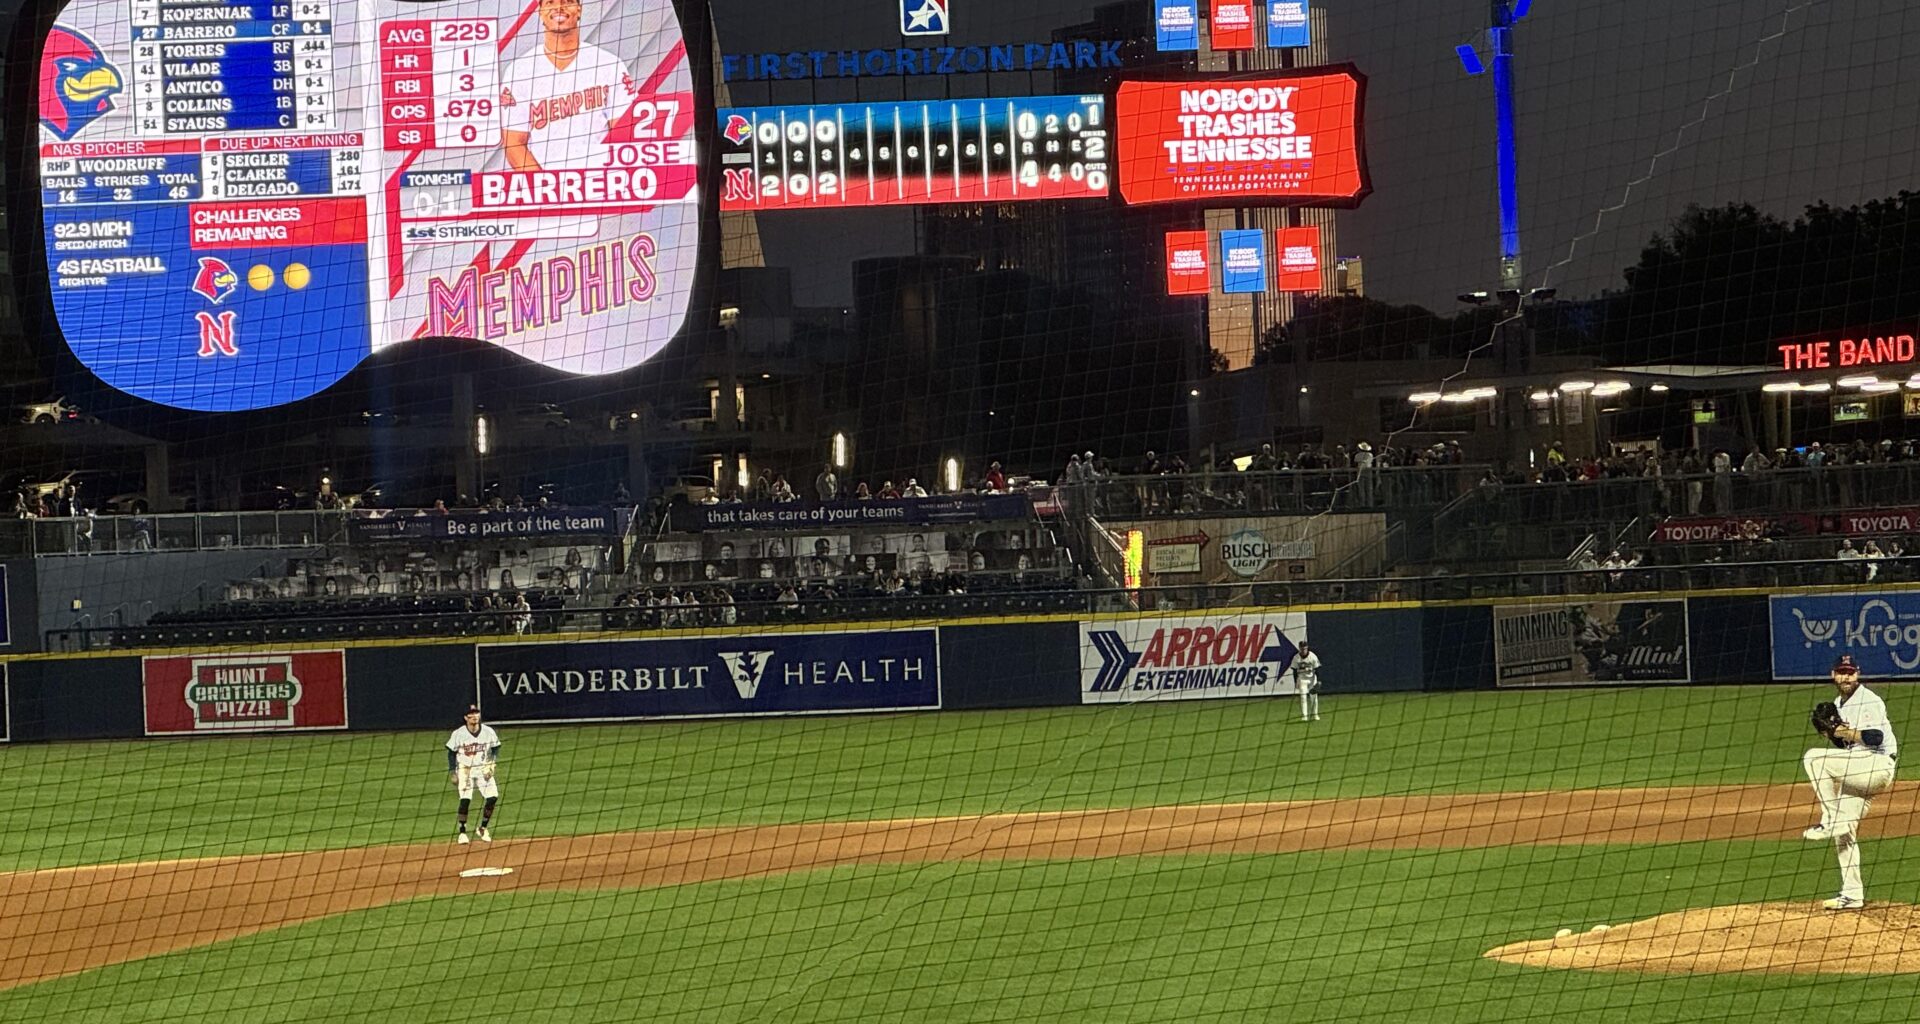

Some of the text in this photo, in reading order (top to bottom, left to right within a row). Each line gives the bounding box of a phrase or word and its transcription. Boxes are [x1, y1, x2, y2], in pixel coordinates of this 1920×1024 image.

[141, 5, 320, 21] 7 KOPERNIAK LF 0-2
[142, 23, 322, 39] 27 BARRERO CF 0-1
[387, 23, 490, 43] AVG .229
[140, 41, 325, 58] 28 TORRES RF .444
[394, 49, 469, 68] HR 1
[722, 40, 1124, 81] FIRST HORIZON PARK
[141, 60, 323, 76] 41 VILADE 3B 0-1
[145, 78, 323, 94] 3 ANTICO DH 0-1
[394, 74, 474, 94] RBI 3
[166, 96, 324, 113] COLLINS 1B 0-1
[1181, 87, 1293, 113] NOBODY
[391, 99, 492, 119] OPS .679
[1088, 104, 1099, 125] 1
[143, 114, 325, 131] 51 STAUSS C 0-1
[633, 100, 680, 140] 27
[758, 112, 1082, 144] 0 0 0 0 2 0
[1178, 112, 1296, 138] TRASHES
[220, 134, 358, 150] DUE UP NEXT INNING
[398, 125, 477, 145] SB 0
[53, 142, 145, 155] NAS PITCHER
[603, 143, 680, 167] JOSE
[765, 139, 1081, 163] 1 2 3 4 5 6 7 8 9 R H E
[1085, 137, 1105, 159] 2
[1163, 136, 1312, 163] TENNESSEE
[47, 158, 167, 173] RHP WOODRUFF
[211, 151, 360, 167] 6 SEIGLER .280
[46, 173, 198, 188] BALLS STRIKES TOTAL
[211, 171, 218, 181] 7
[225, 168, 287, 181] CLARKE
[407, 173, 465, 186] TONIGHT
[723, 160, 1084, 200] N 2 0 2 4 4 0
[1087, 171, 1105, 190] 0
[1174, 172, 1309, 184] TENNESSEE DEPARTMENT
[58, 186, 189, 203] 14 32 46
[212, 180, 361, 196] 8 DELGADO .171
[482, 168, 658, 205] BARRERO
[1202, 181, 1299, 191] TRANSPORTATION
[194, 208, 301, 224] CHALLENGES
[53, 221, 132, 238] 92.9 MPH
[195, 226, 288, 242] REMAINING
[406, 224, 515, 239] 1st STRIKEOUT
[55, 239, 127, 250] SPEED OF PITCH
[57, 257, 167, 275] 4S FASTBALL
[59, 277, 107, 287] PITCH TYPE
[426, 234, 658, 340] MEMPHIS
[195, 311, 239, 357] N
[1778, 335, 1914, 370] THE BAND
[707, 506, 904, 523] that takes care of your teams
[447, 520, 466, 534] Be
[469, 523, 477, 534] a
[482, 519, 513, 536] part
[517, 516, 532, 532] of
[536, 516, 561, 531] the
[565, 515, 605, 529] team
[1850, 516, 1911, 532] TOYOTA
[1664, 526, 1719, 540] TOYOTA
[1222, 543, 1272, 560] BUSCH
[1232, 559, 1263, 568] LIGHT
[1500, 610, 1568, 644] WINNING
[1139, 623, 1273, 668] ARROW
[1627, 645, 1683, 666] Mint
[215, 667, 267, 684] HUNT
[493, 650, 923, 699] VANDERBILT V HEALTH
[1133, 666, 1270, 691] EXTERMINATORS
[195, 684, 290, 701] BROTHERS
[215, 700, 271, 717] PIZZA
